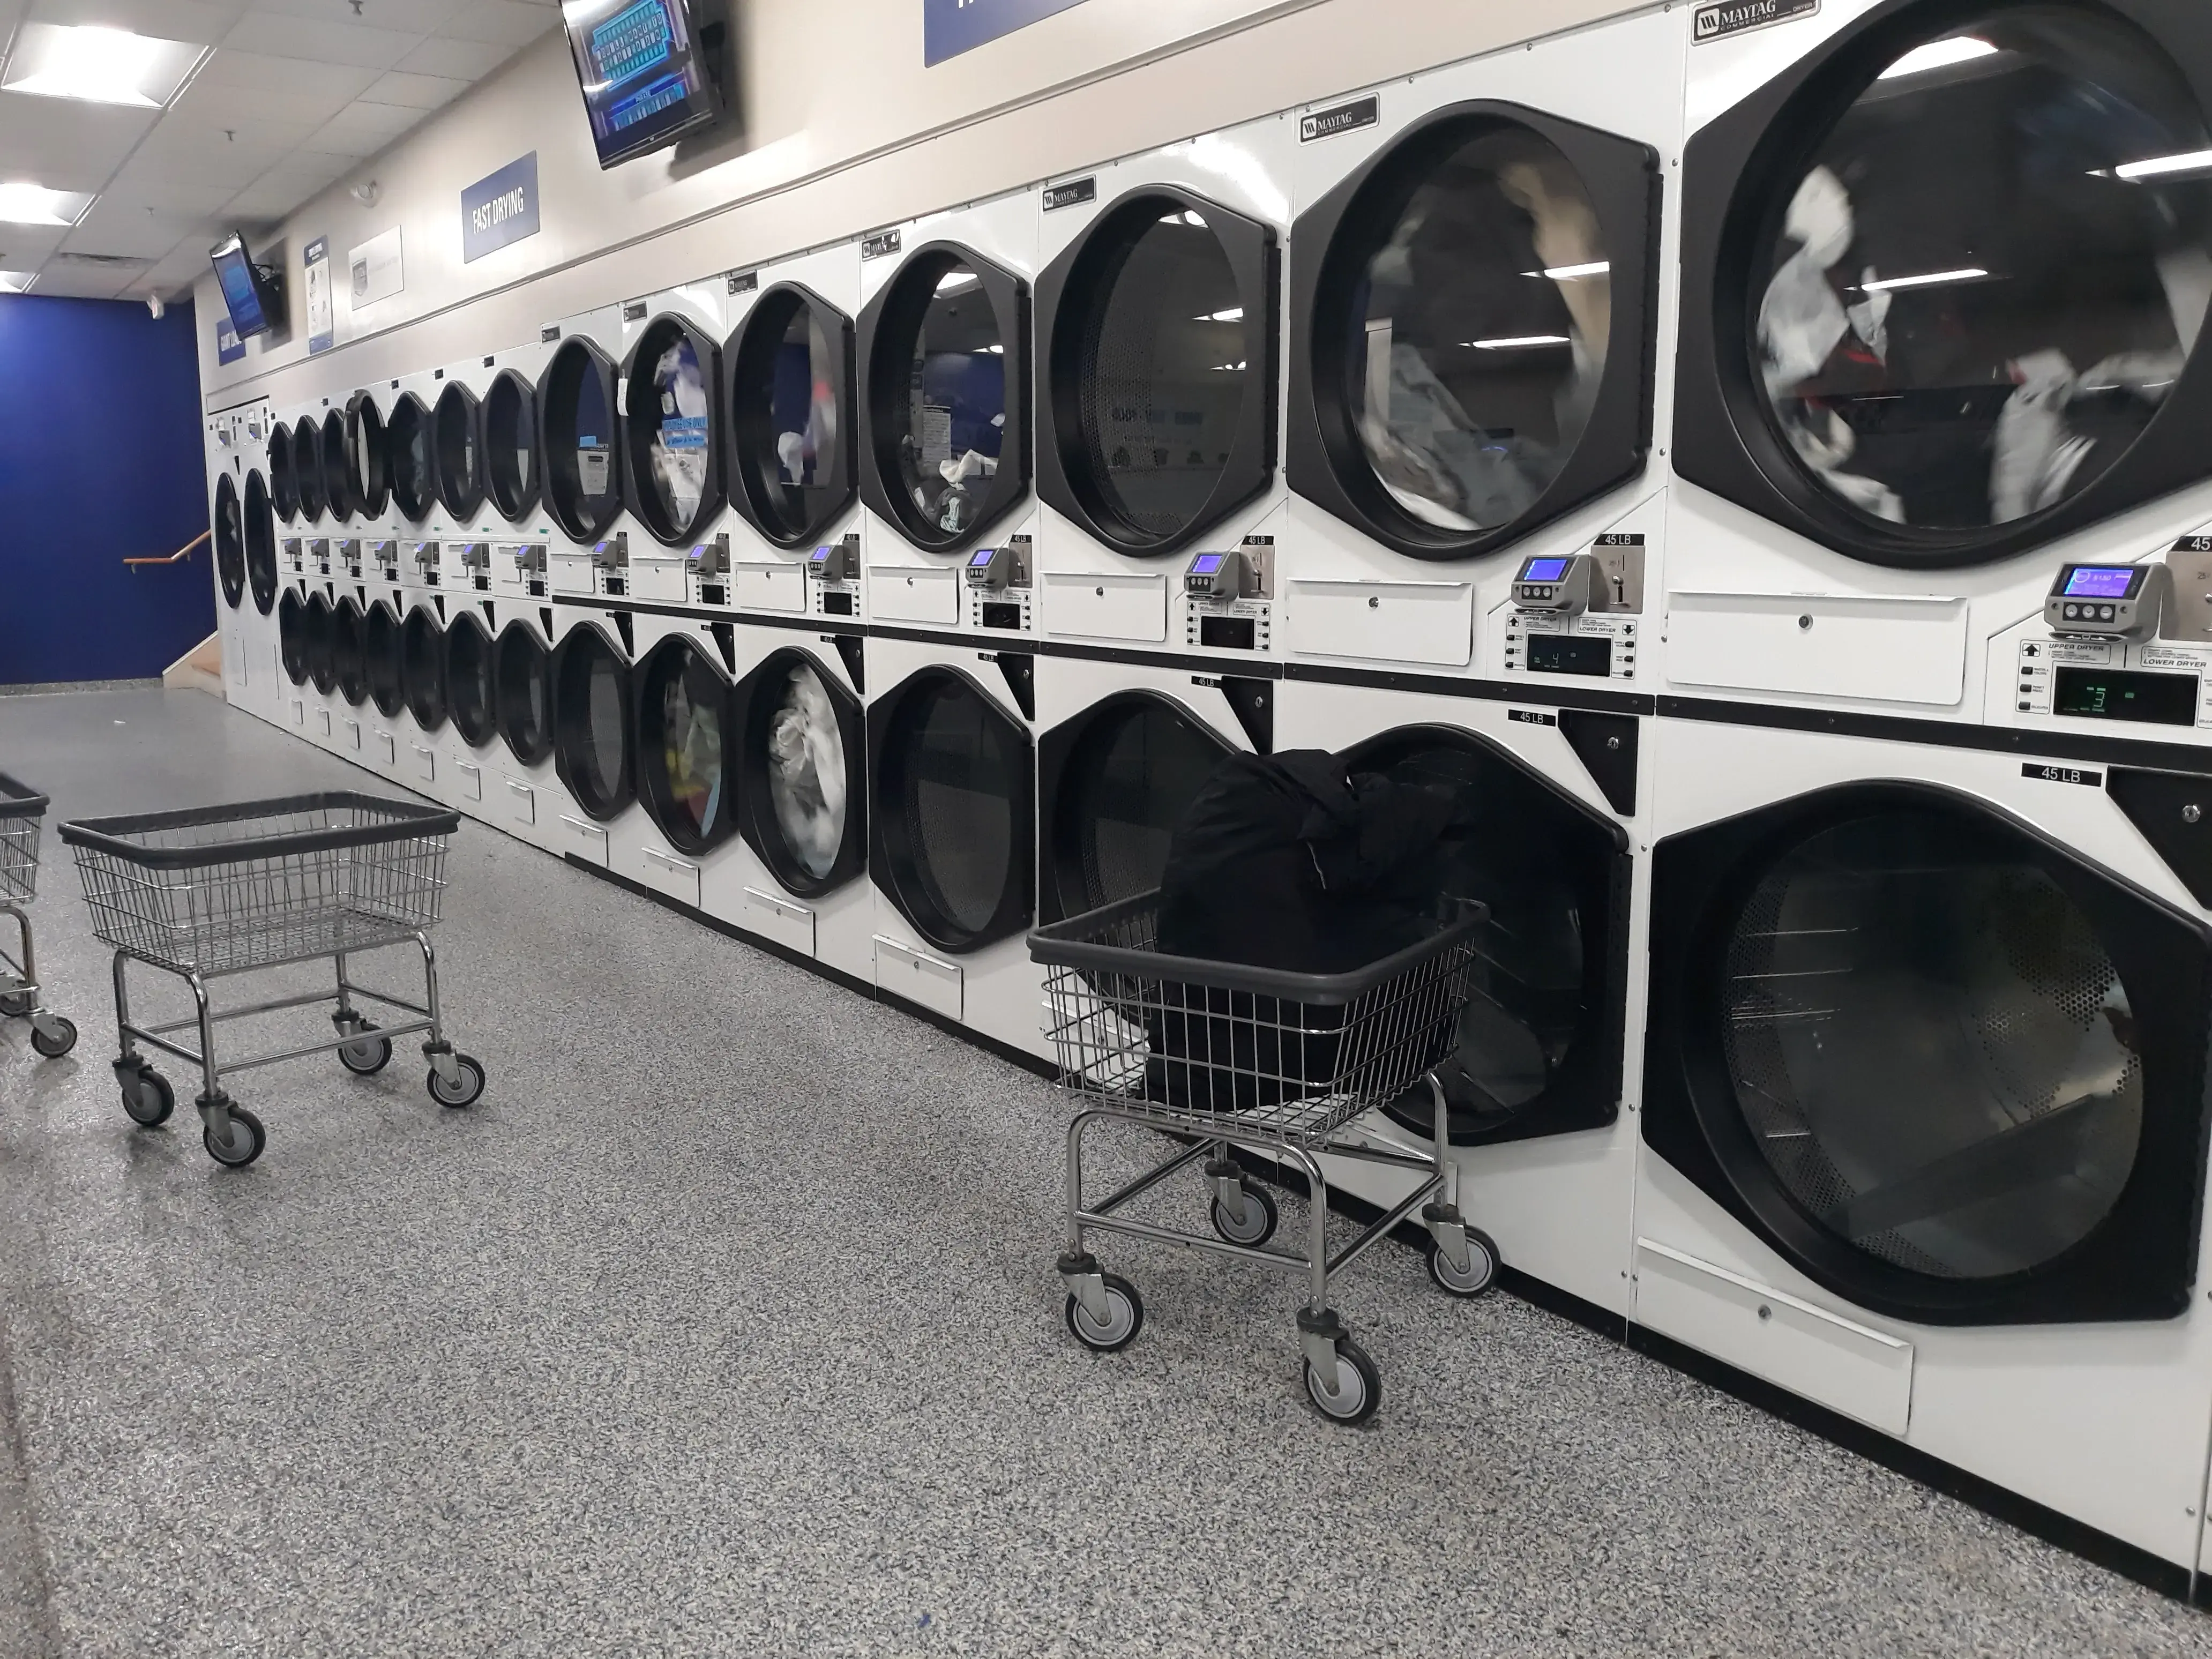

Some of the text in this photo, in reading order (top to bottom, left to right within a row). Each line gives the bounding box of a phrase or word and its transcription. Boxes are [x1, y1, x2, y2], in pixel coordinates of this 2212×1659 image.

[1721, 0, 1776, 25] MAYTAG
[1317, 111, 1352, 131] MAYTAG
[1053, 188, 1078, 203] MAYTAG
[473, 185, 524, 235] FAST DRYING
[1249, 536, 1265, 544] 45 LB
[1605, 534, 1631, 545] 45 LB
[2191, 537, 2210, 551] 45
[2049, 642, 2075, 651] UPPER
[1199, 677, 1214, 687] 45 LB
[1520, 712, 1544, 724] 45 LB
[2042, 767, 2081, 783] 45 LB
